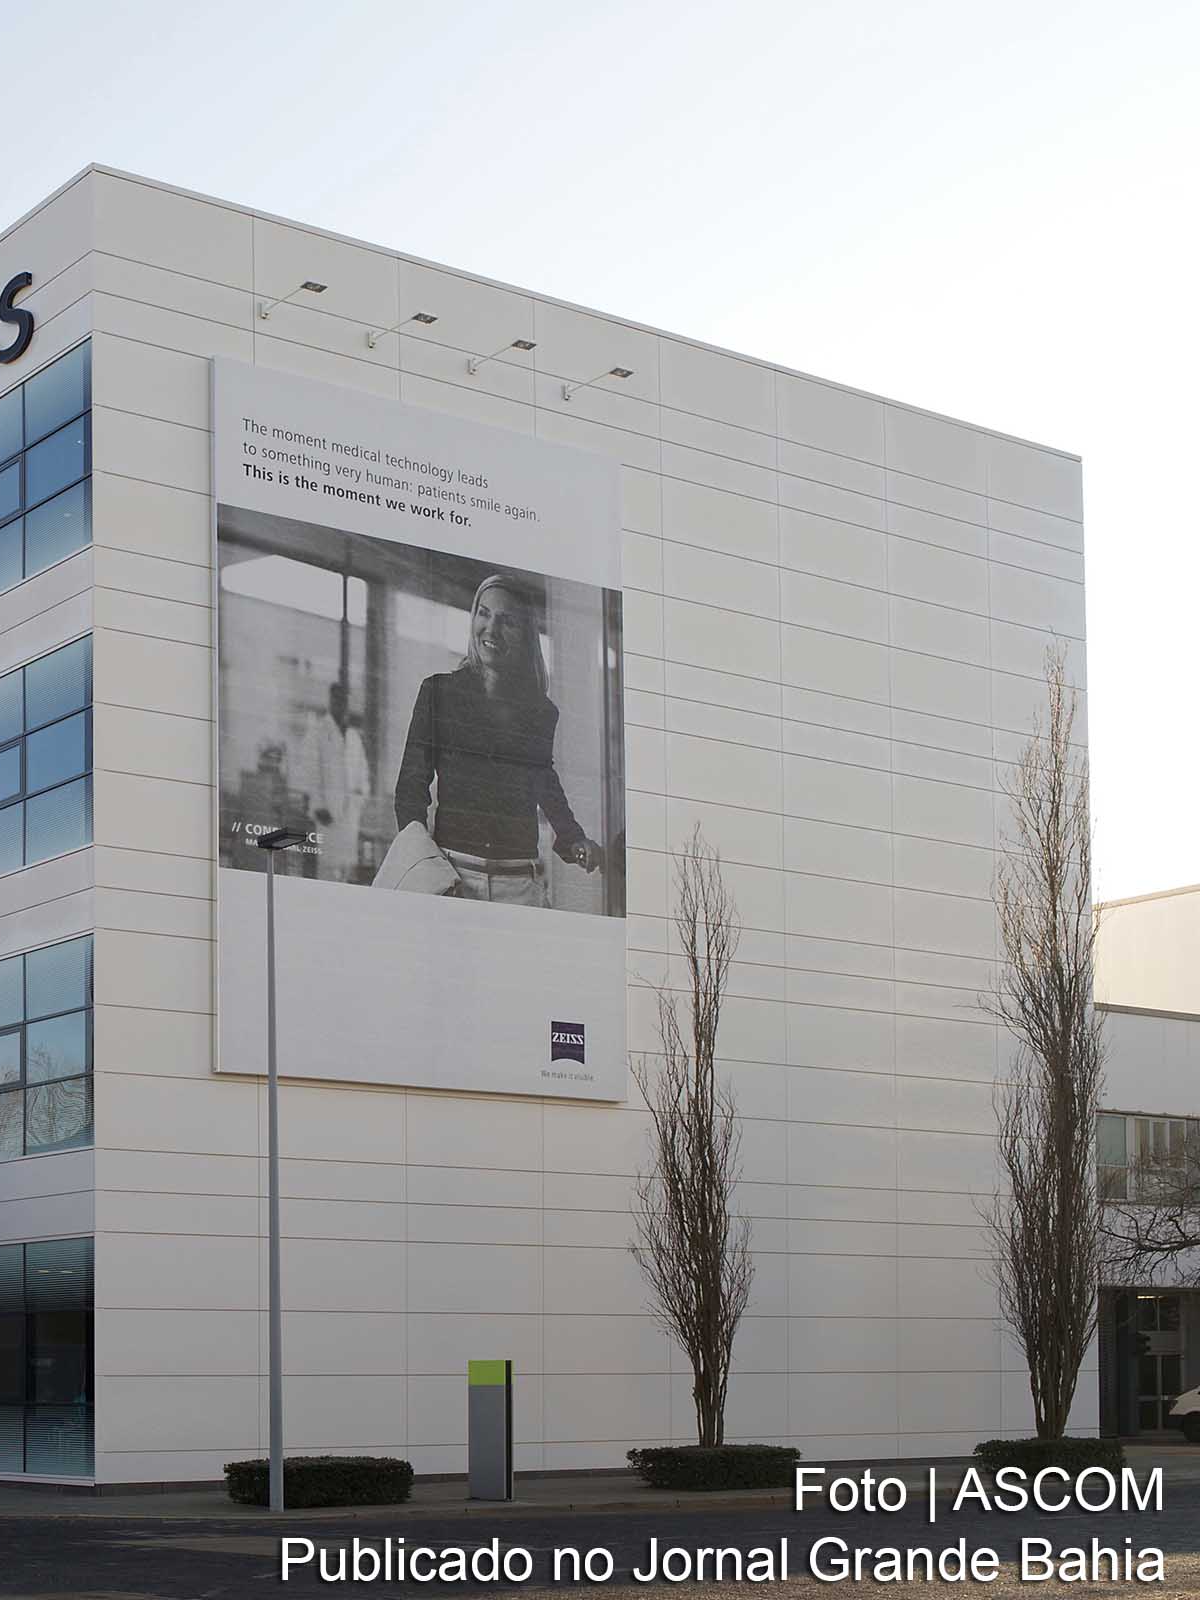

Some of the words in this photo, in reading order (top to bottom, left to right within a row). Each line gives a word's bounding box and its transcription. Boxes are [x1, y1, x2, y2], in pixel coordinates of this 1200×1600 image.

[242, 417, 268, 436] The
[272, 427, 327, 450] moment
[332, 441, 381, 463] medical
[385, 453, 454, 483] technology
[458, 469, 489, 489] leads
[243, 441, 257, 456] to
[261, 447, 331, 476] something
[335, 464, 362, 483] very
[366, 469, 413, 492] human:
[417, 483, 467, 505] patients
[470, 495, 501, 513] smile
[504, 504, 541, 523] again.
[242, 463, 273, 482] This
[278, 470, 290, 486] is
[294, 475, 318, 492] the
[323, 483, 381, 506] moment
[385, 498, 406, 512] we
[410, 502, 445, 521] work
[449, 510, 472, 527] for.
[552, 1031, 584, 1045] ZEISS
